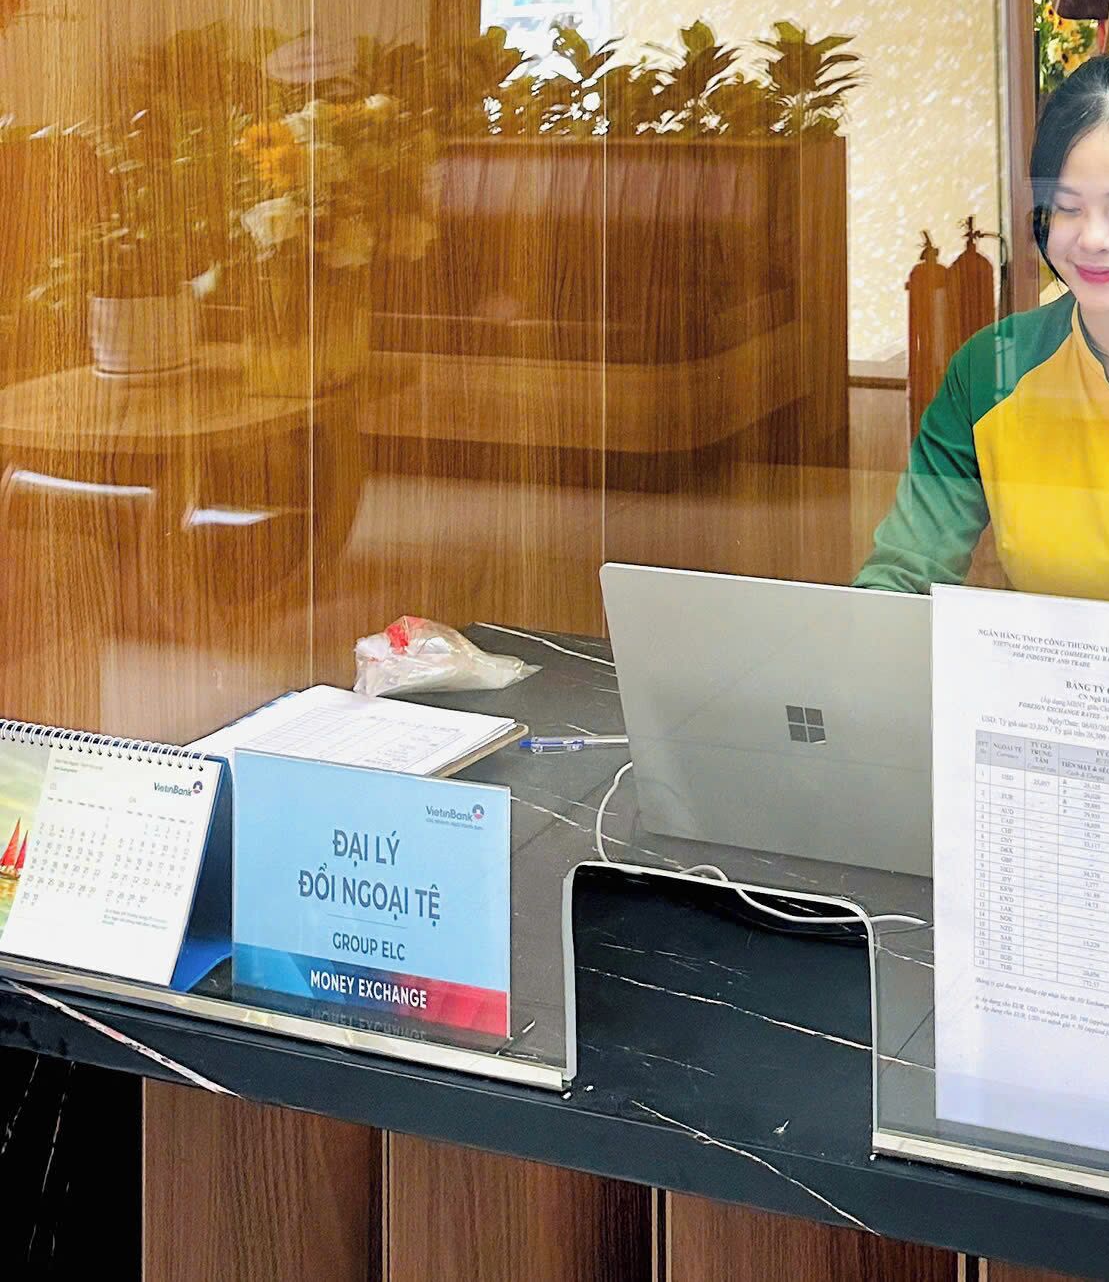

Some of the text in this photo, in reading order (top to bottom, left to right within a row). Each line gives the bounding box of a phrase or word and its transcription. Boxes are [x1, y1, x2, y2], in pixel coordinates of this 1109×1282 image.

[1065, 679, 1091, 693] BẢNG
[153, 781, 193, 797] VietinBank
[425, 804, 473, 822] VietinBank
[332, 828, 400, 867] ĐẠI LÝ
[298, 862, 441, 927] ĐỔI NGOẠI TỆ
[332, 931, 406, 962] GROUP ELC
[310, 969, 427, 1010] MONEY EXCHANGE
